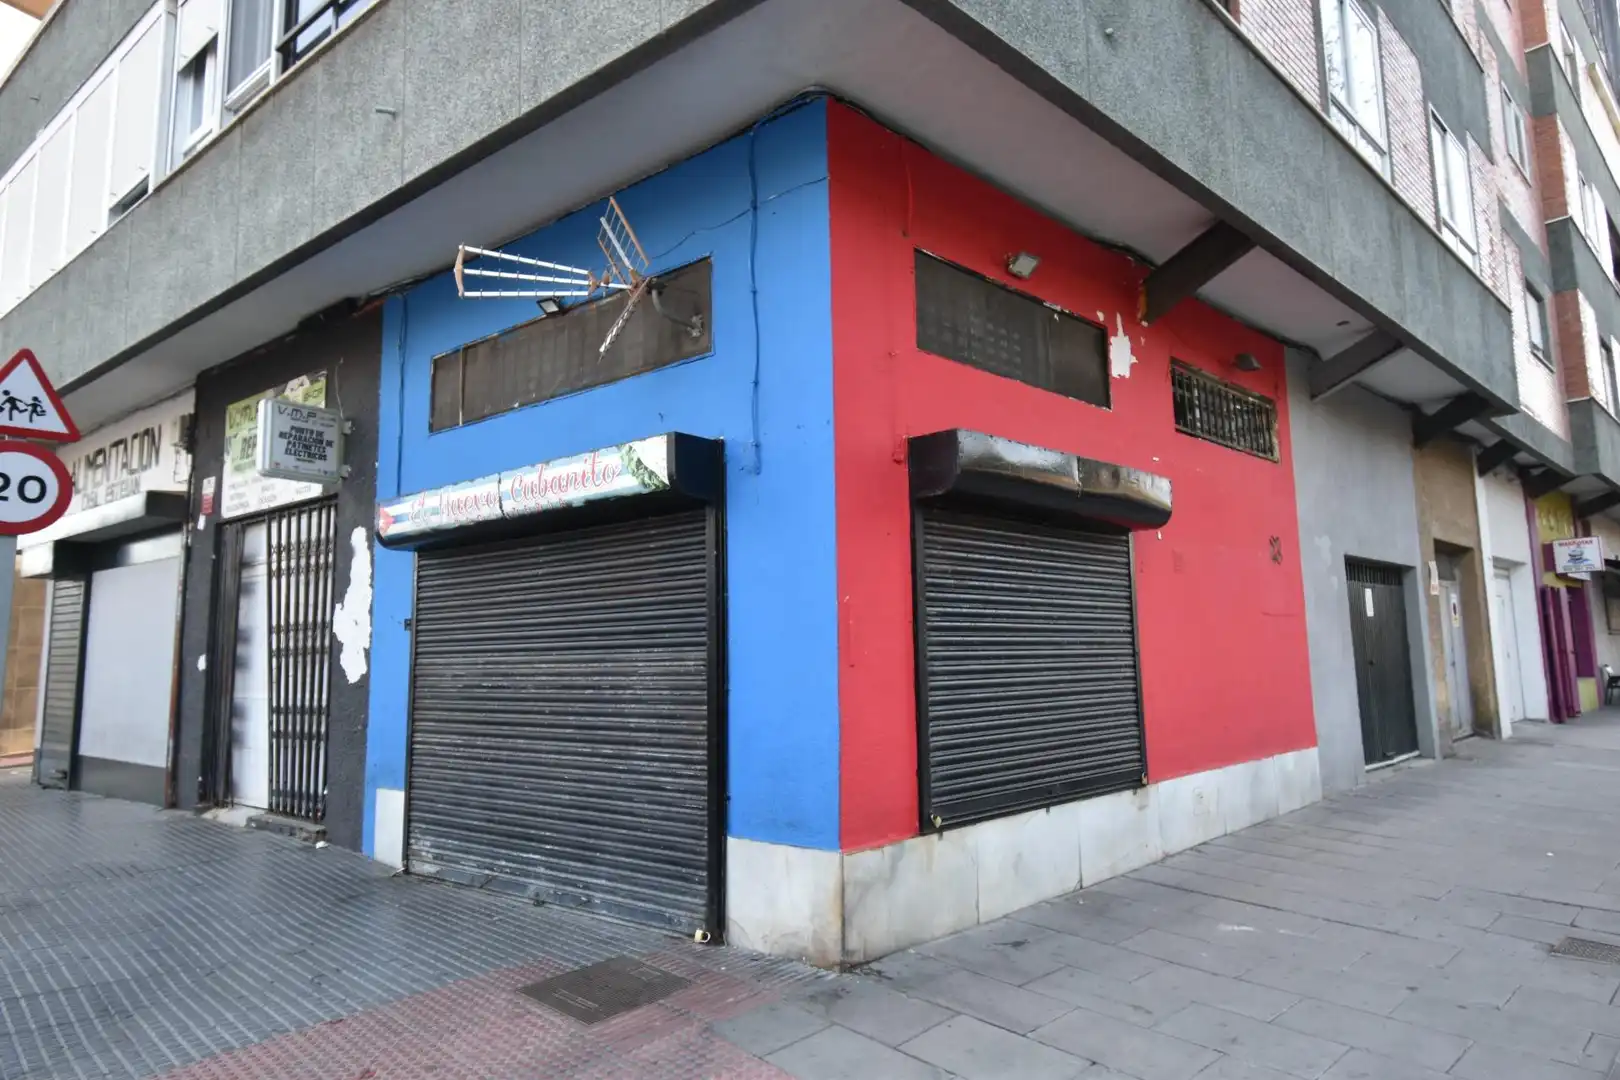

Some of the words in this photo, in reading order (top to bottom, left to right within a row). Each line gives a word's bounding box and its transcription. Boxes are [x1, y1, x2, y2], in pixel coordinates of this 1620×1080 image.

[290, 425, 314, 436] PUNTO
[287, 440, 326, 454] PATINETES
[510, 450, 621, 503] Cubanito
